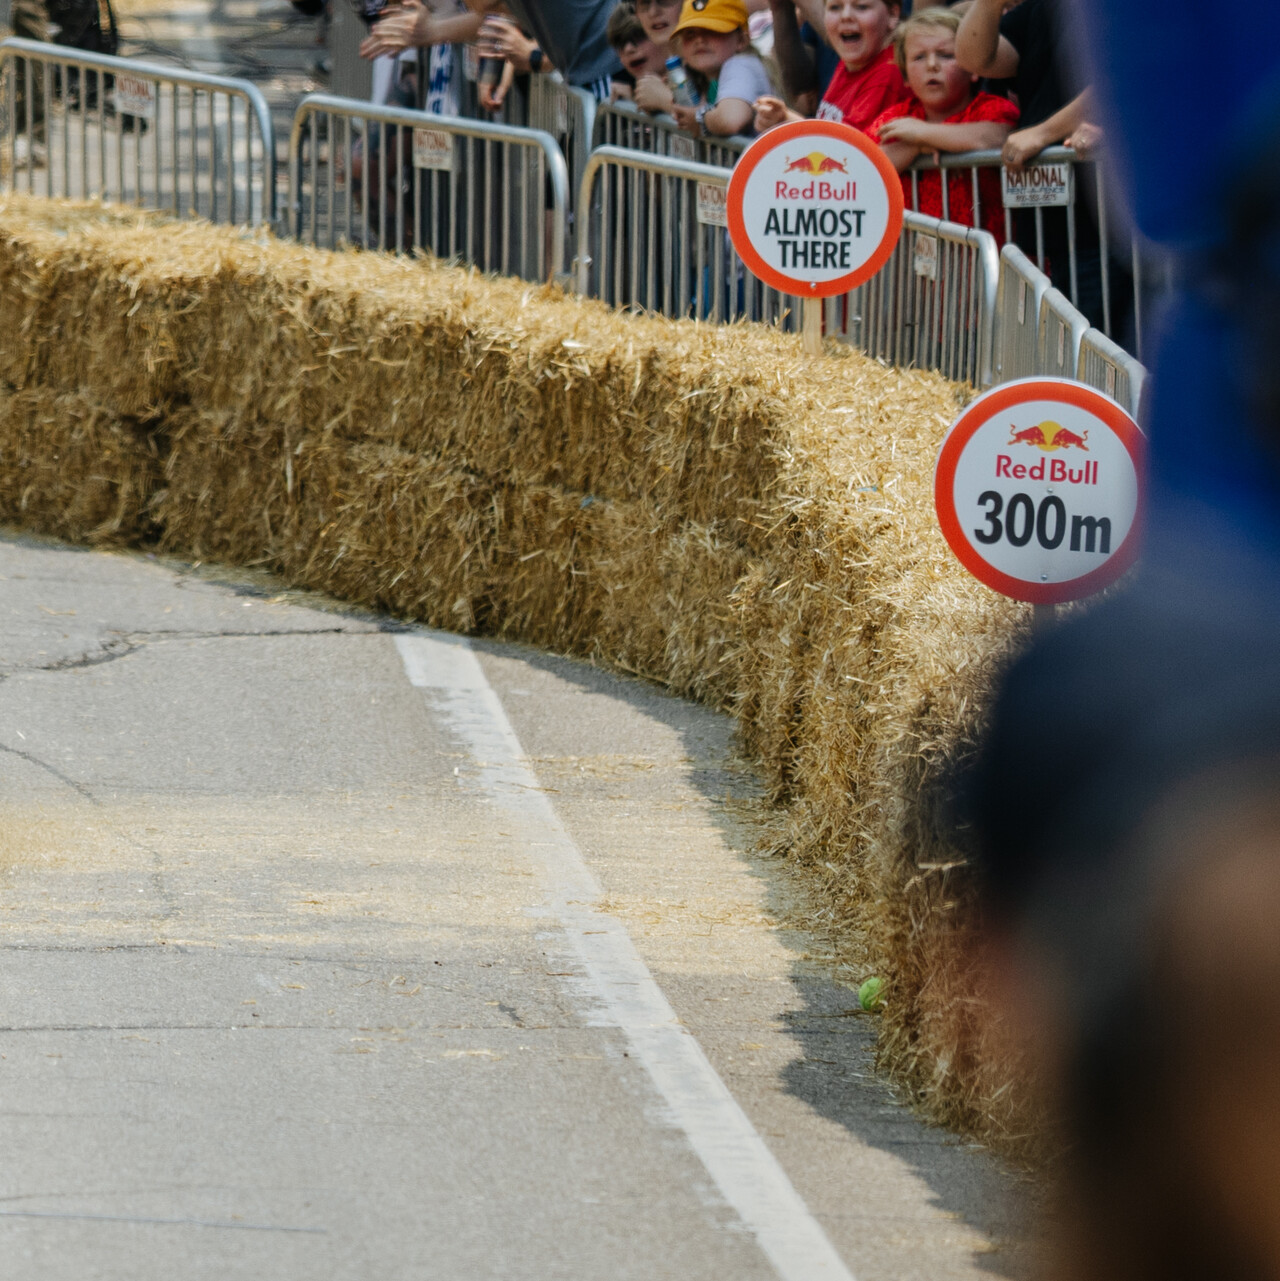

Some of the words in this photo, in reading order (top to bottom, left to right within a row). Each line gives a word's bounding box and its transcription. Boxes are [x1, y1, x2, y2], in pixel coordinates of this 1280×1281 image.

[775, 181, 815, 200] Red
[819, 181, 857, 201] Bull
[764, 208, 866, 237] ALMOST
[777, 240, 851, 269] THERE
[995, 454, 1045, 480] Red
[1050, 459, 1099, 485] Bull
[974, 490, 1112, 554] 300m
